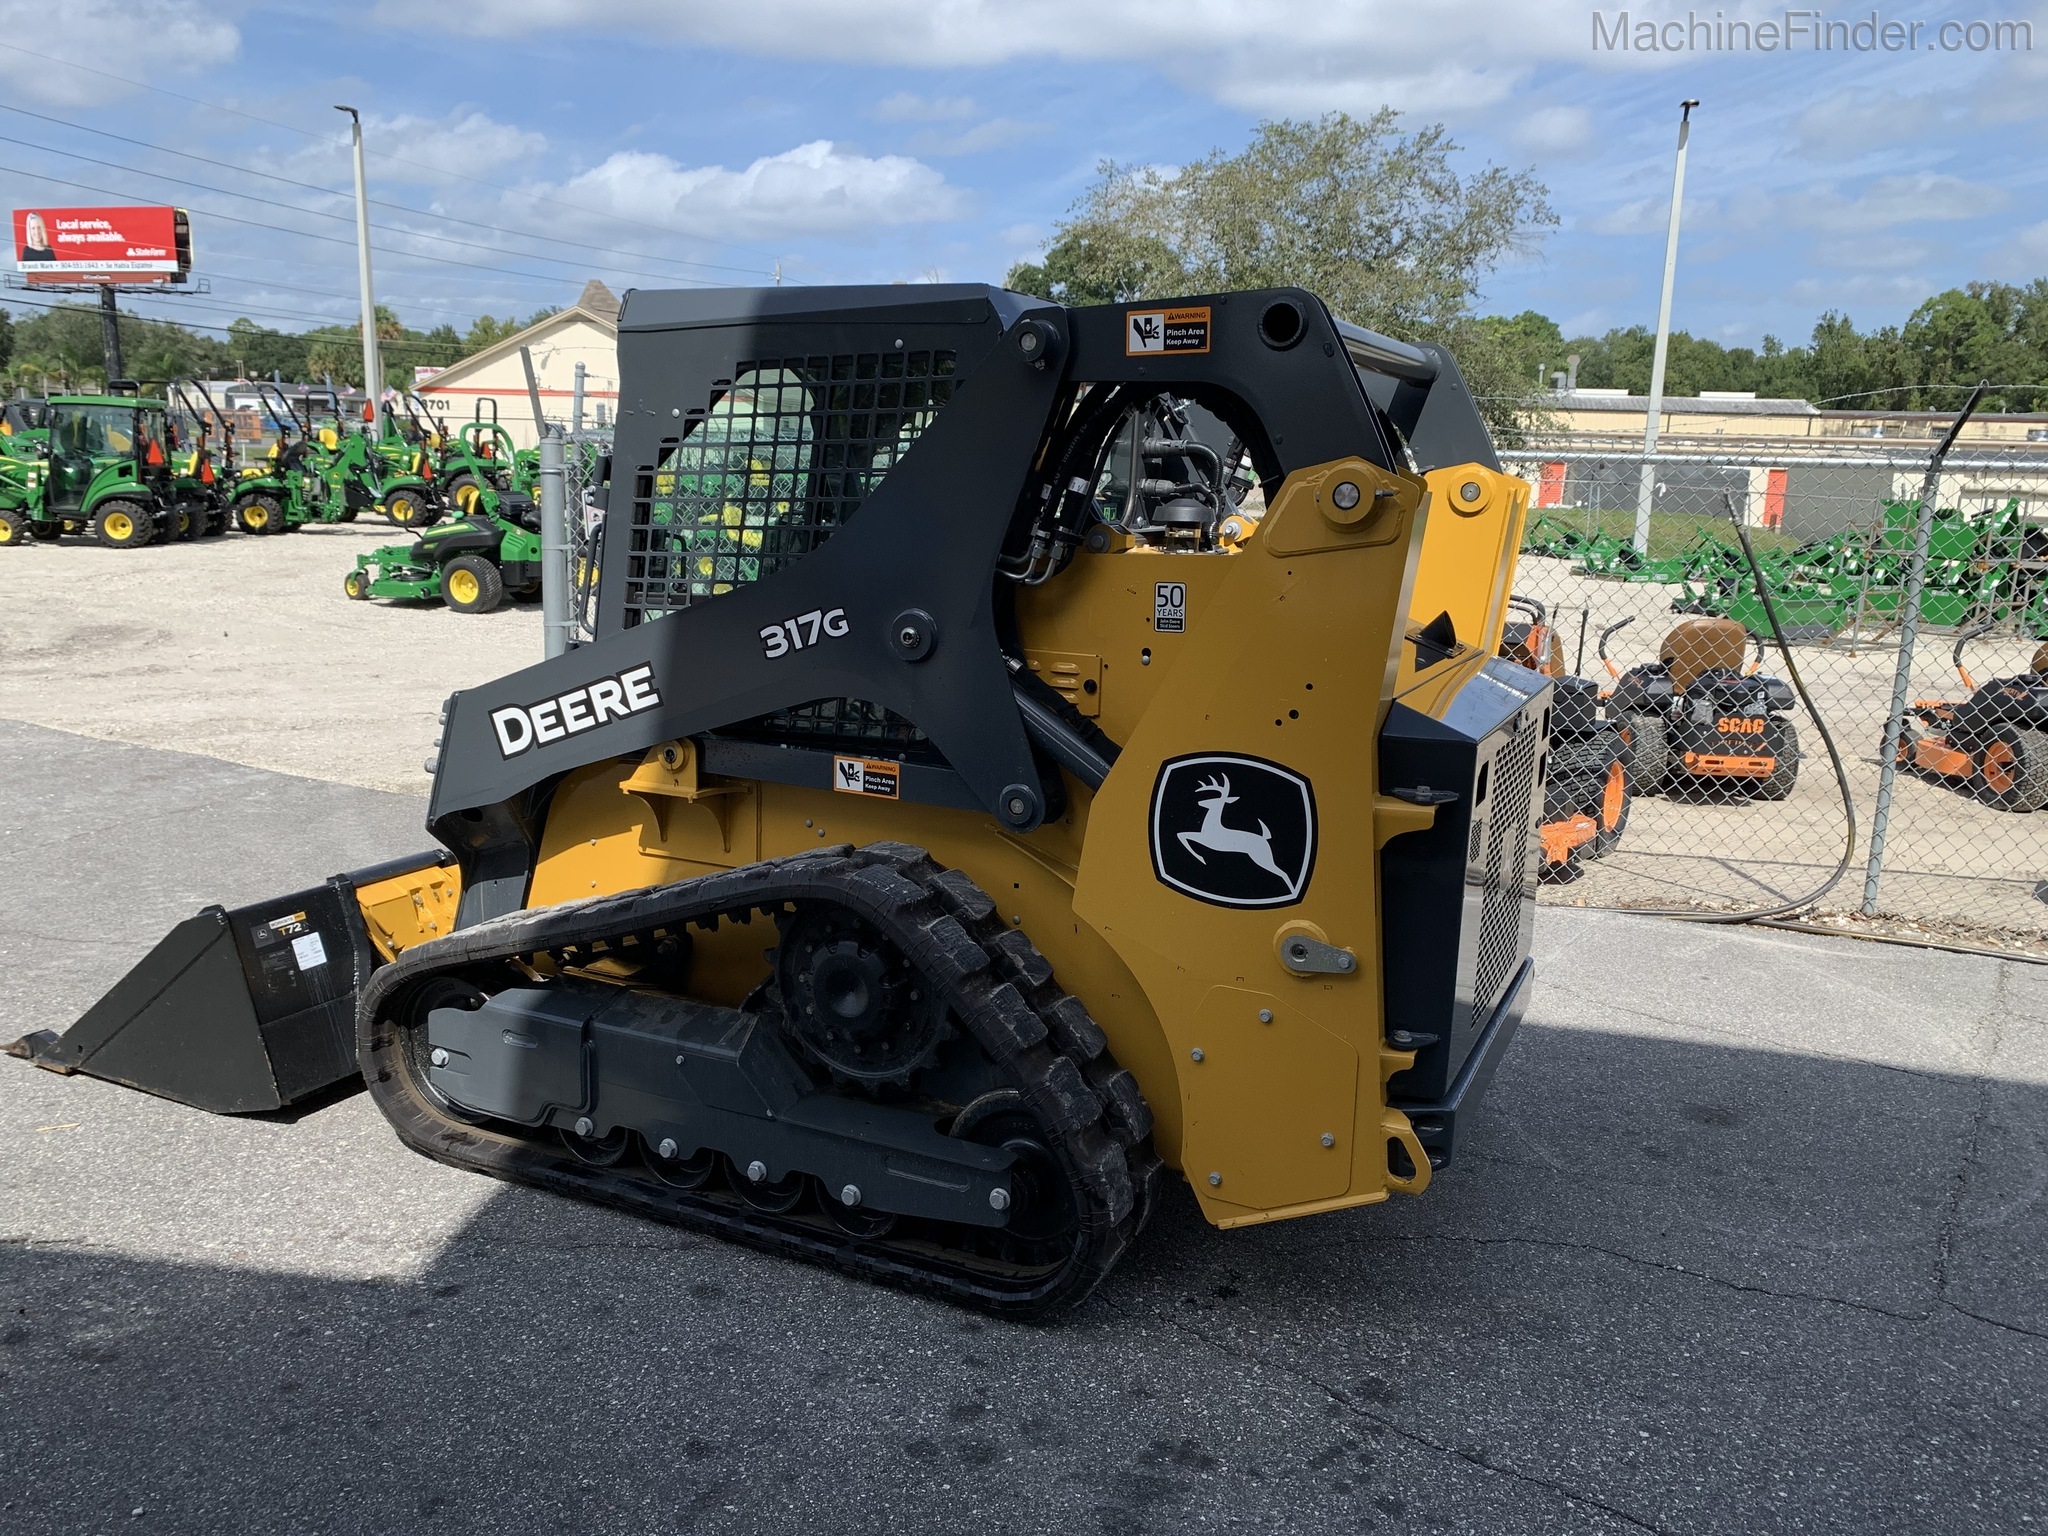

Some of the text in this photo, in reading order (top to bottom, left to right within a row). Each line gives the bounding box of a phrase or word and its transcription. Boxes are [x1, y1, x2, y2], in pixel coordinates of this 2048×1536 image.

[56, 218, 112, 231] Local service,
[57, 231, 125, 245] always available.
[1174, 312, 1206, 321] WARNING
[1166, 328, 1204, 337] Pinch Area
[1166, 338, 1199, 346] Keep Away
[1157, 585, 1184, 608] 50
[1157, 609, 1183, 617] YEARS
[759, 608, 850, 658] 317G
[491, 666, 660, 756] DEERE
[1718, 717, 1764, 734] SCAG
[871, 763, 896, 773] WARNING
[865, 775, 895, 785] Pinch Area
[877, 784, 891, 792] Away
[278, 922, 302, 936] T72
